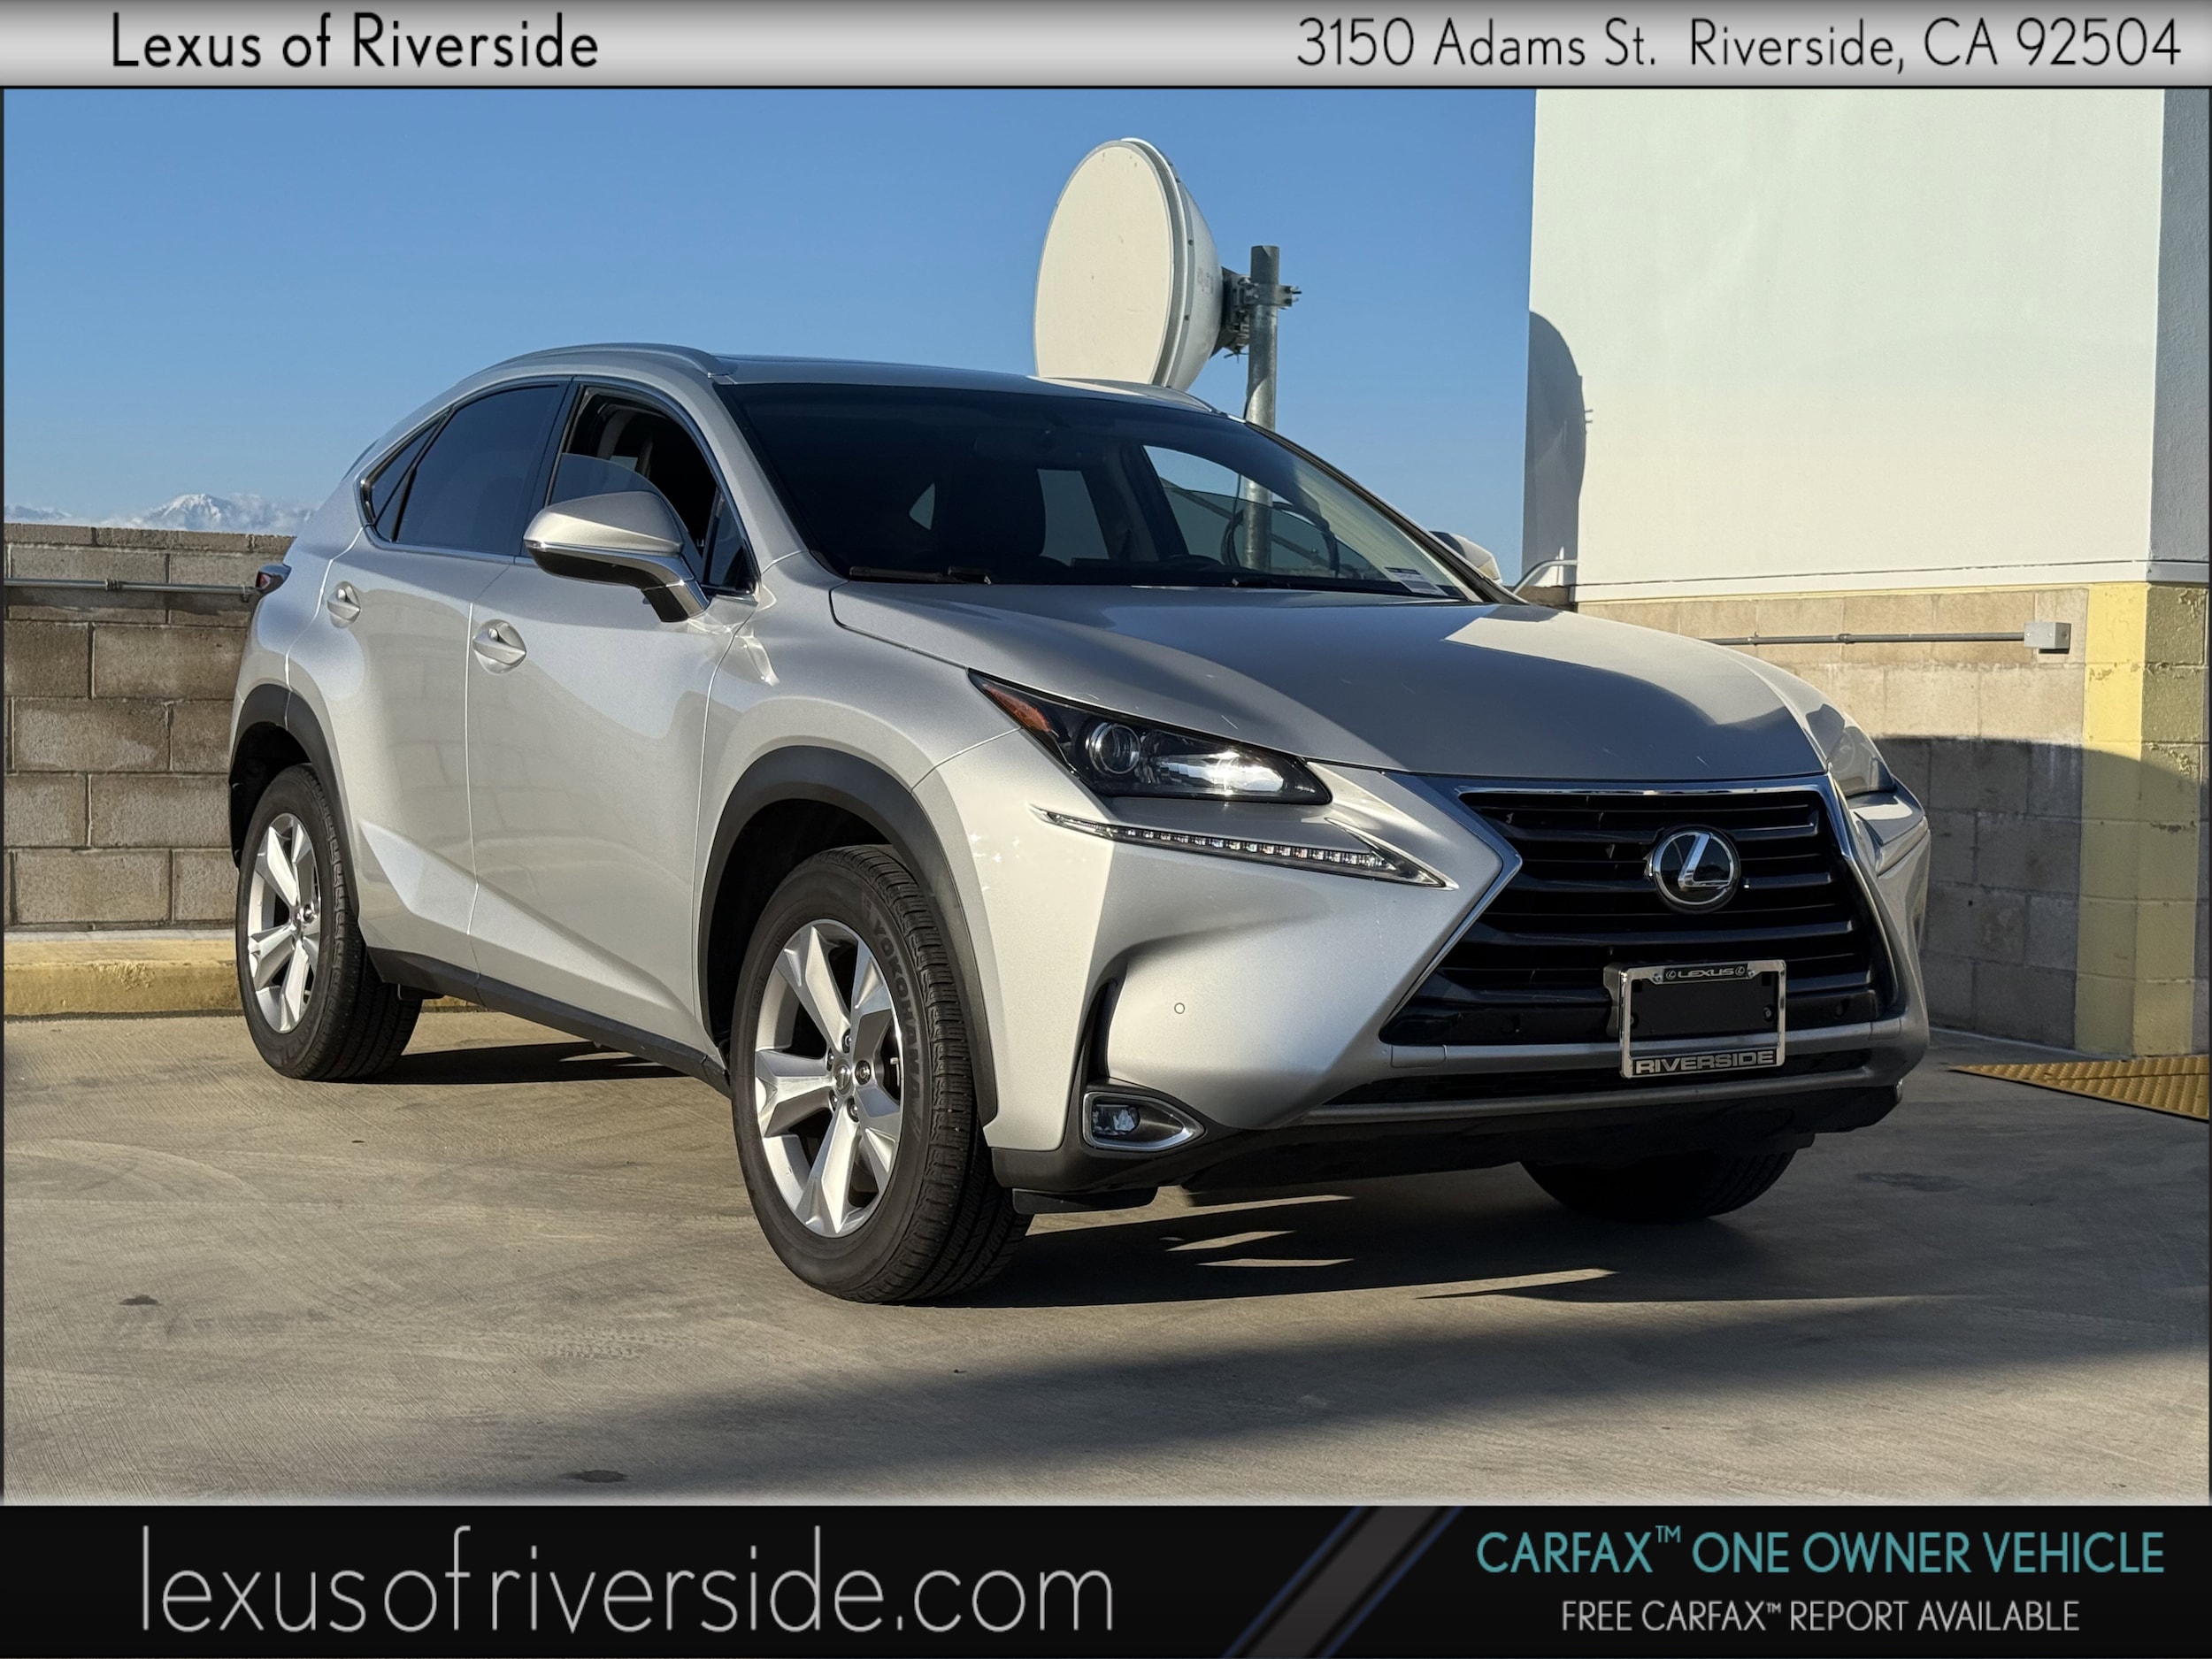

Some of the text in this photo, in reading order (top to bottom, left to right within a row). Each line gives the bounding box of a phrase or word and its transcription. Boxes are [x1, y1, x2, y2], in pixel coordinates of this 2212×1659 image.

[1678, 967, 1735, 979] LEXUS
[872, 918, 922, 1102] YOKOHAMA
[1635, 1050, 1774, 1074] RIVERSIDE
